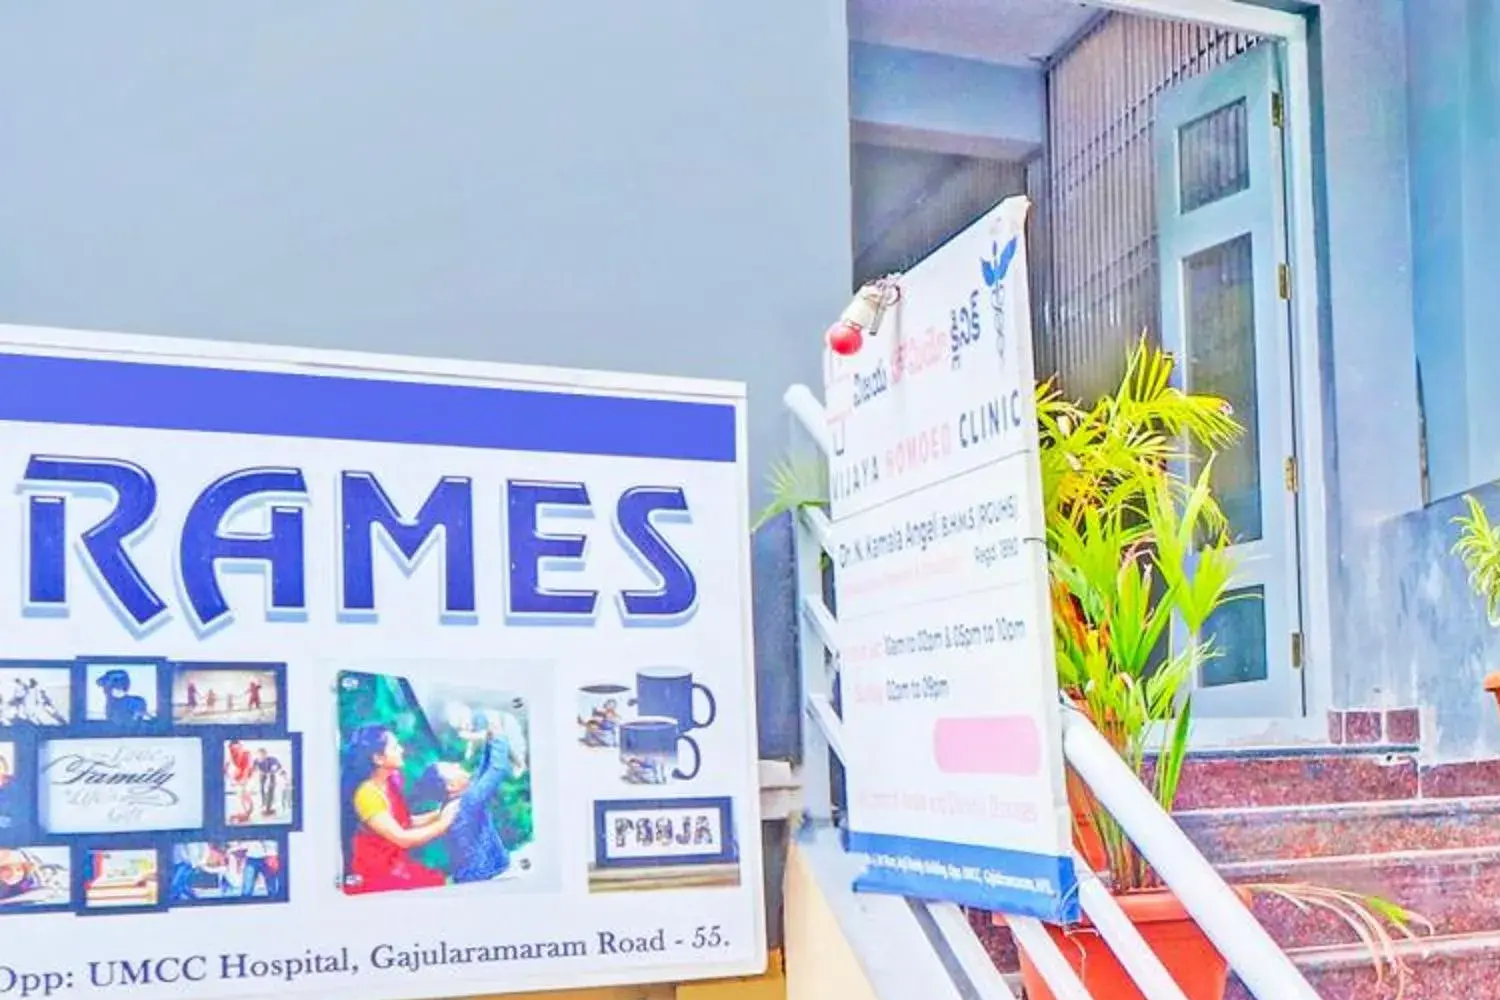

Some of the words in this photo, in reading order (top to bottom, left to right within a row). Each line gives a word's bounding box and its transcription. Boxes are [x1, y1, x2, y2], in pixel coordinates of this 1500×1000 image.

[831, 454, 880, 502] VIJAYA
[957, 388, 1022, 450] CLINIC
[14, 452, 699, 640] RAMES
[42, 753, 177, 794] Family
[88, 954, 208, 989] UMCC
[219, 947, 360, 983] Hospital,
[369, 938, 588, 974] Gajularamaram
[596, 928, 666, 957] Road
[690, 924, 732, 950] 55.
